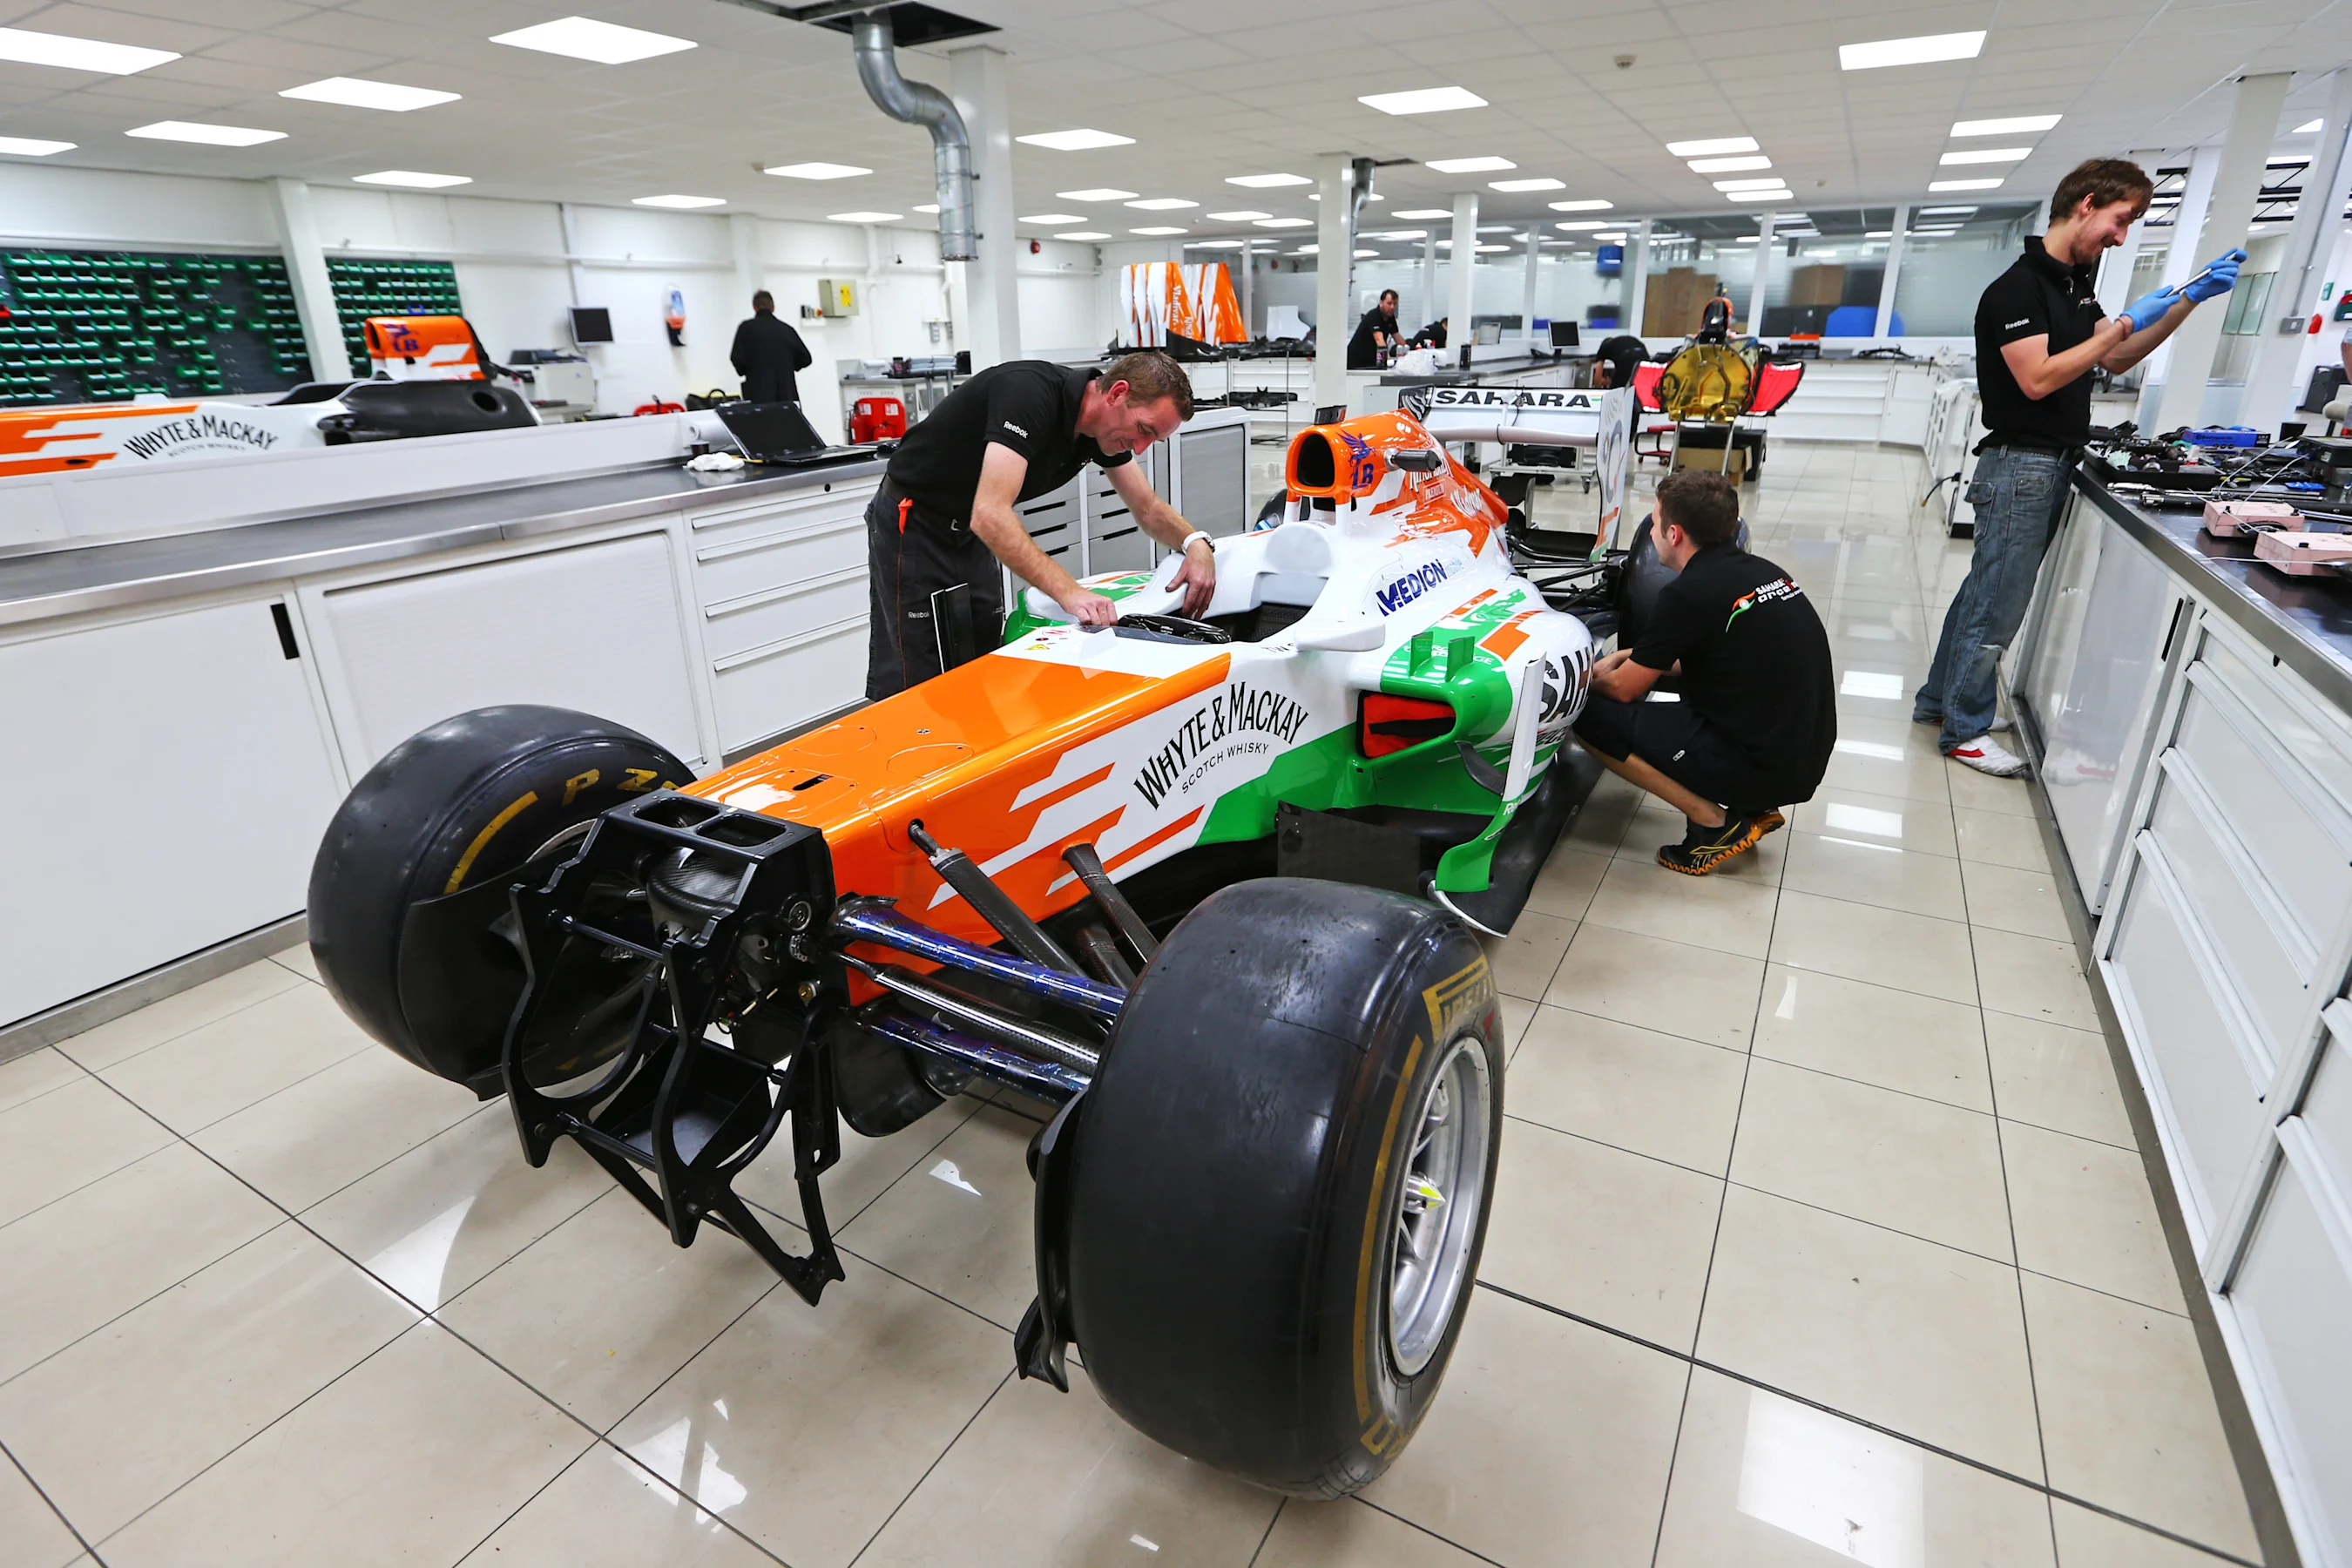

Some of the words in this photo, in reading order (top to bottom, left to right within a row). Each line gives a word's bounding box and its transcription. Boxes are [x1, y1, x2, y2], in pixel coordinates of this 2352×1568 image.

[2004, 318, 2030, 330] Reebok
[1004, 421, 1028, 439] Reebok
[1375, 558, 1448, 617] MEDION
[1133, 706, 1212, 811] WHYTE
[1212, 695, 1226, 742] &
[1227, 681, 1309, 745] MACKAY
[1182, 751, 1224, 794] SCOTCH
[1227, 742, 1269, 759] WHISKY
